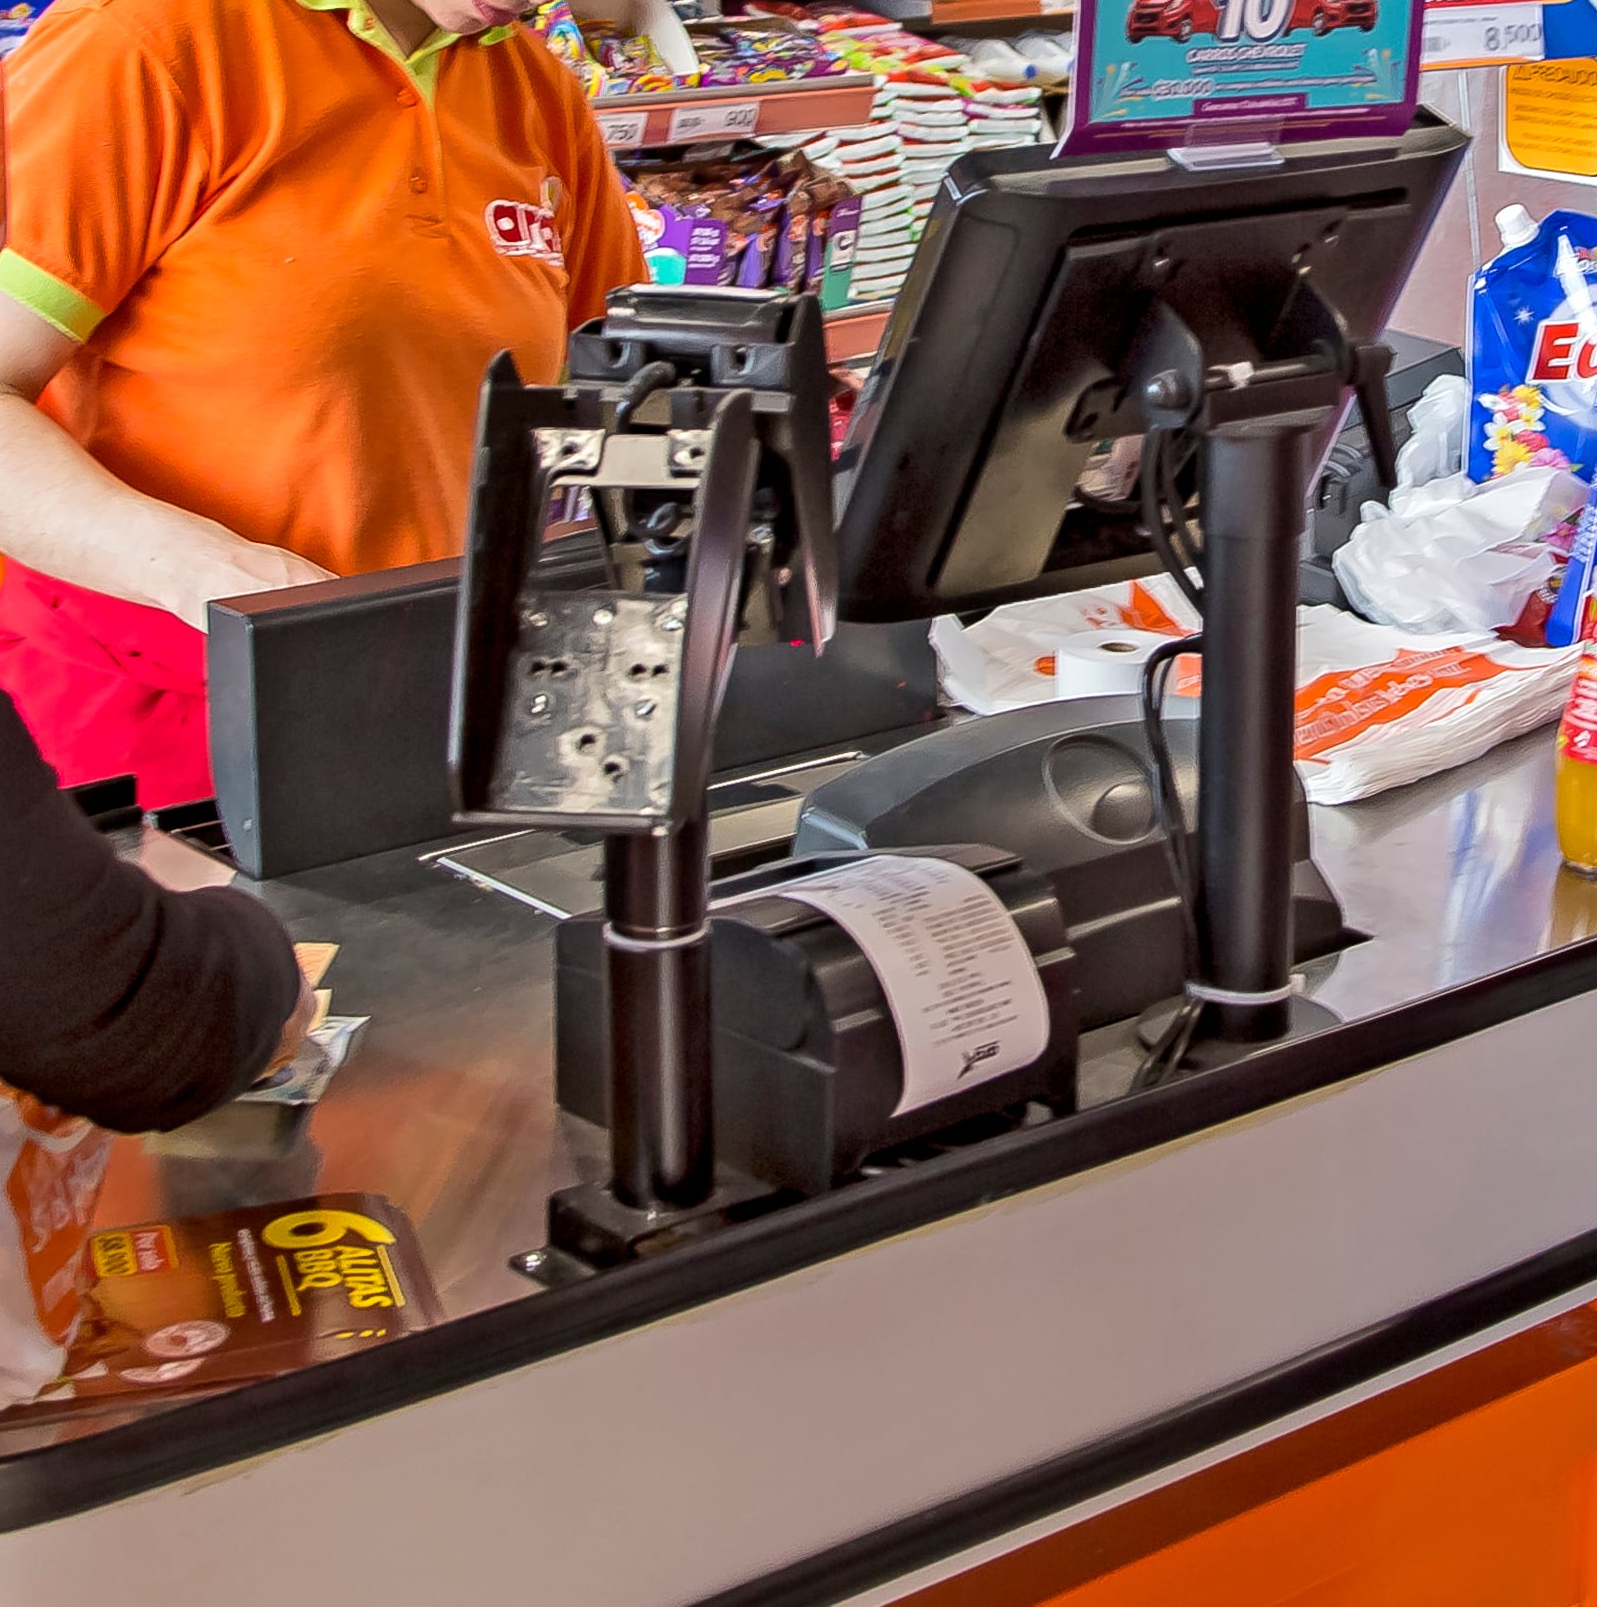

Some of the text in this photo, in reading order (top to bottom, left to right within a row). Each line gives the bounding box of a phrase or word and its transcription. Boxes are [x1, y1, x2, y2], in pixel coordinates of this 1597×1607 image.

[261, 1209, 398, 1249] 6
[293, 1249, 345, 1293] BBQ
[333, 1244, 394, 1309] ALITAS
